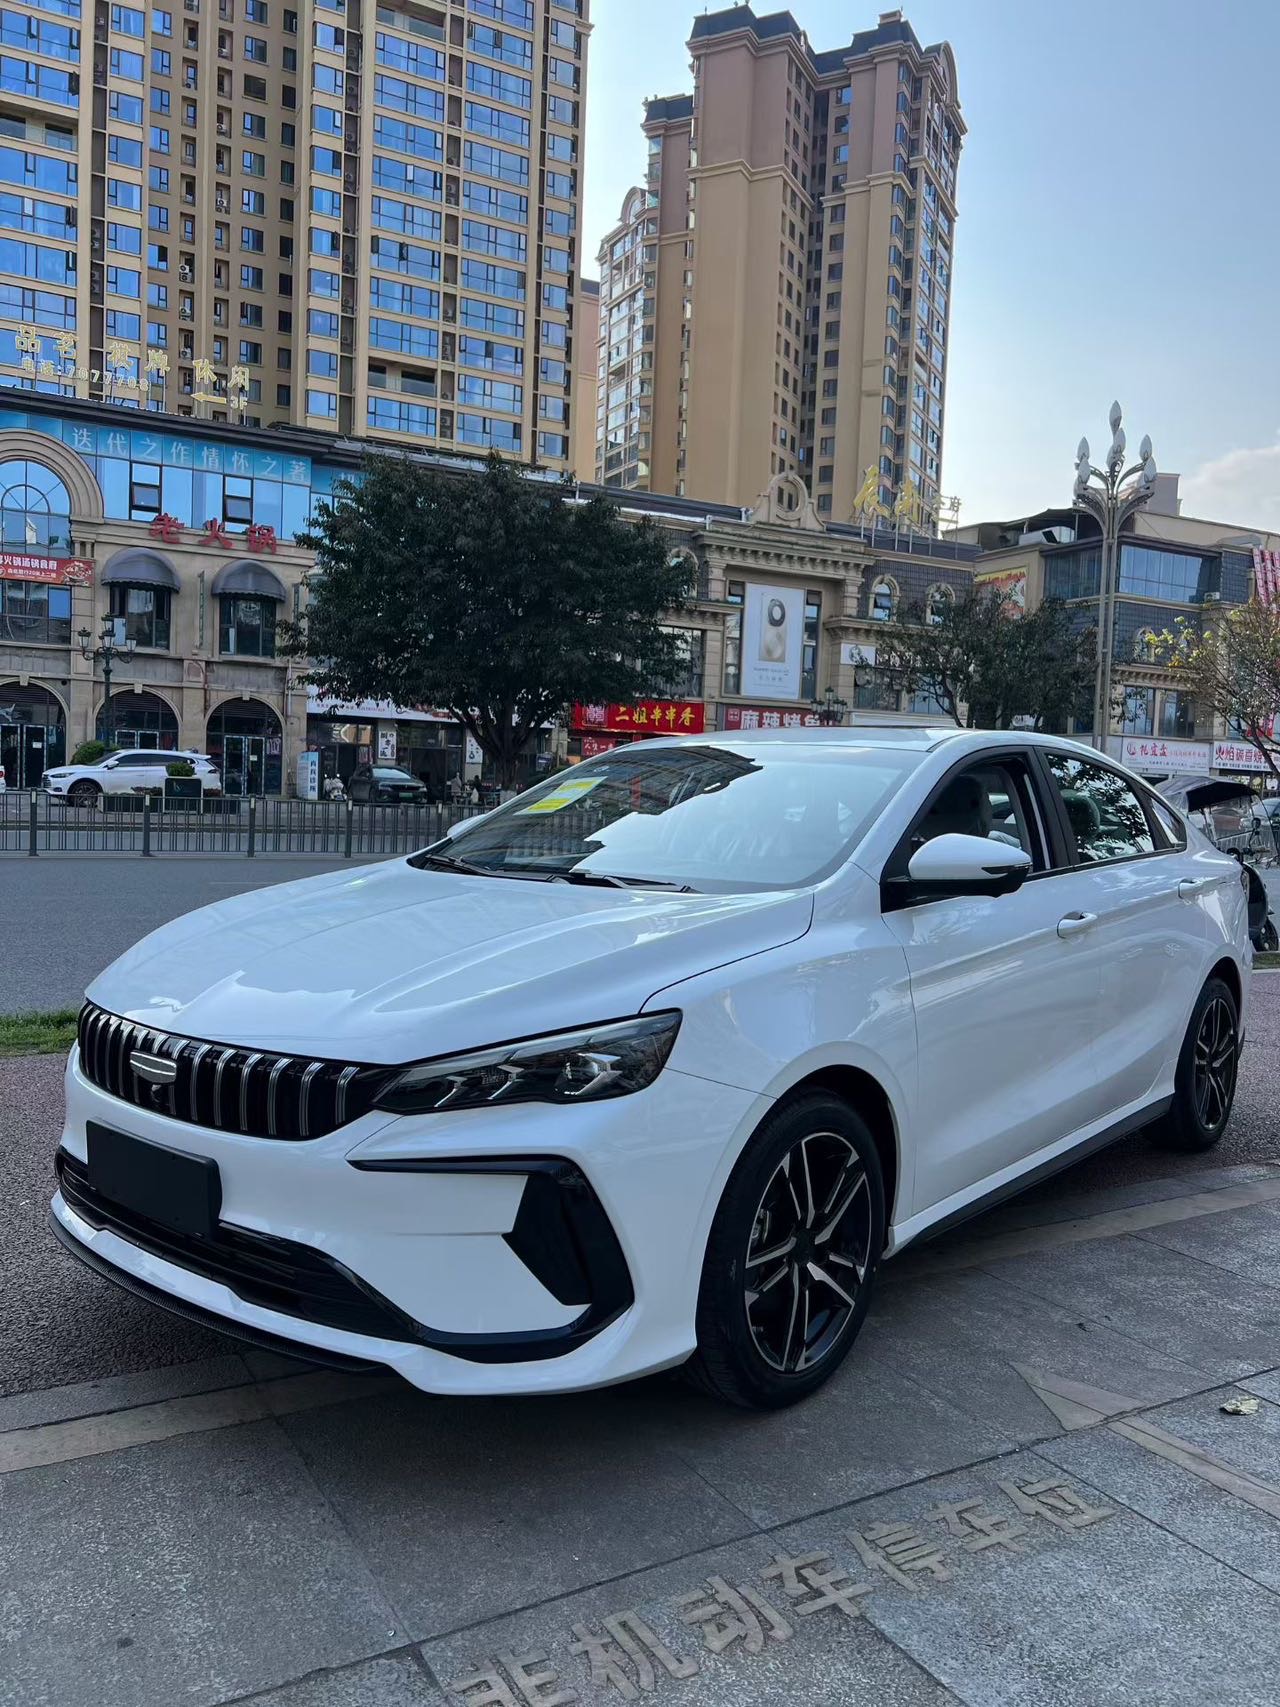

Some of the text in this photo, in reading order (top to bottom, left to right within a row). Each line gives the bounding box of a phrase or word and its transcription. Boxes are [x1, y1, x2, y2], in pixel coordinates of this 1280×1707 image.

[72, 427, 306, 482] 迭代之作情怀之著
[149, 512, 277, 555] 老火锅
[615, 705, 695, 728] 二姐串串香
